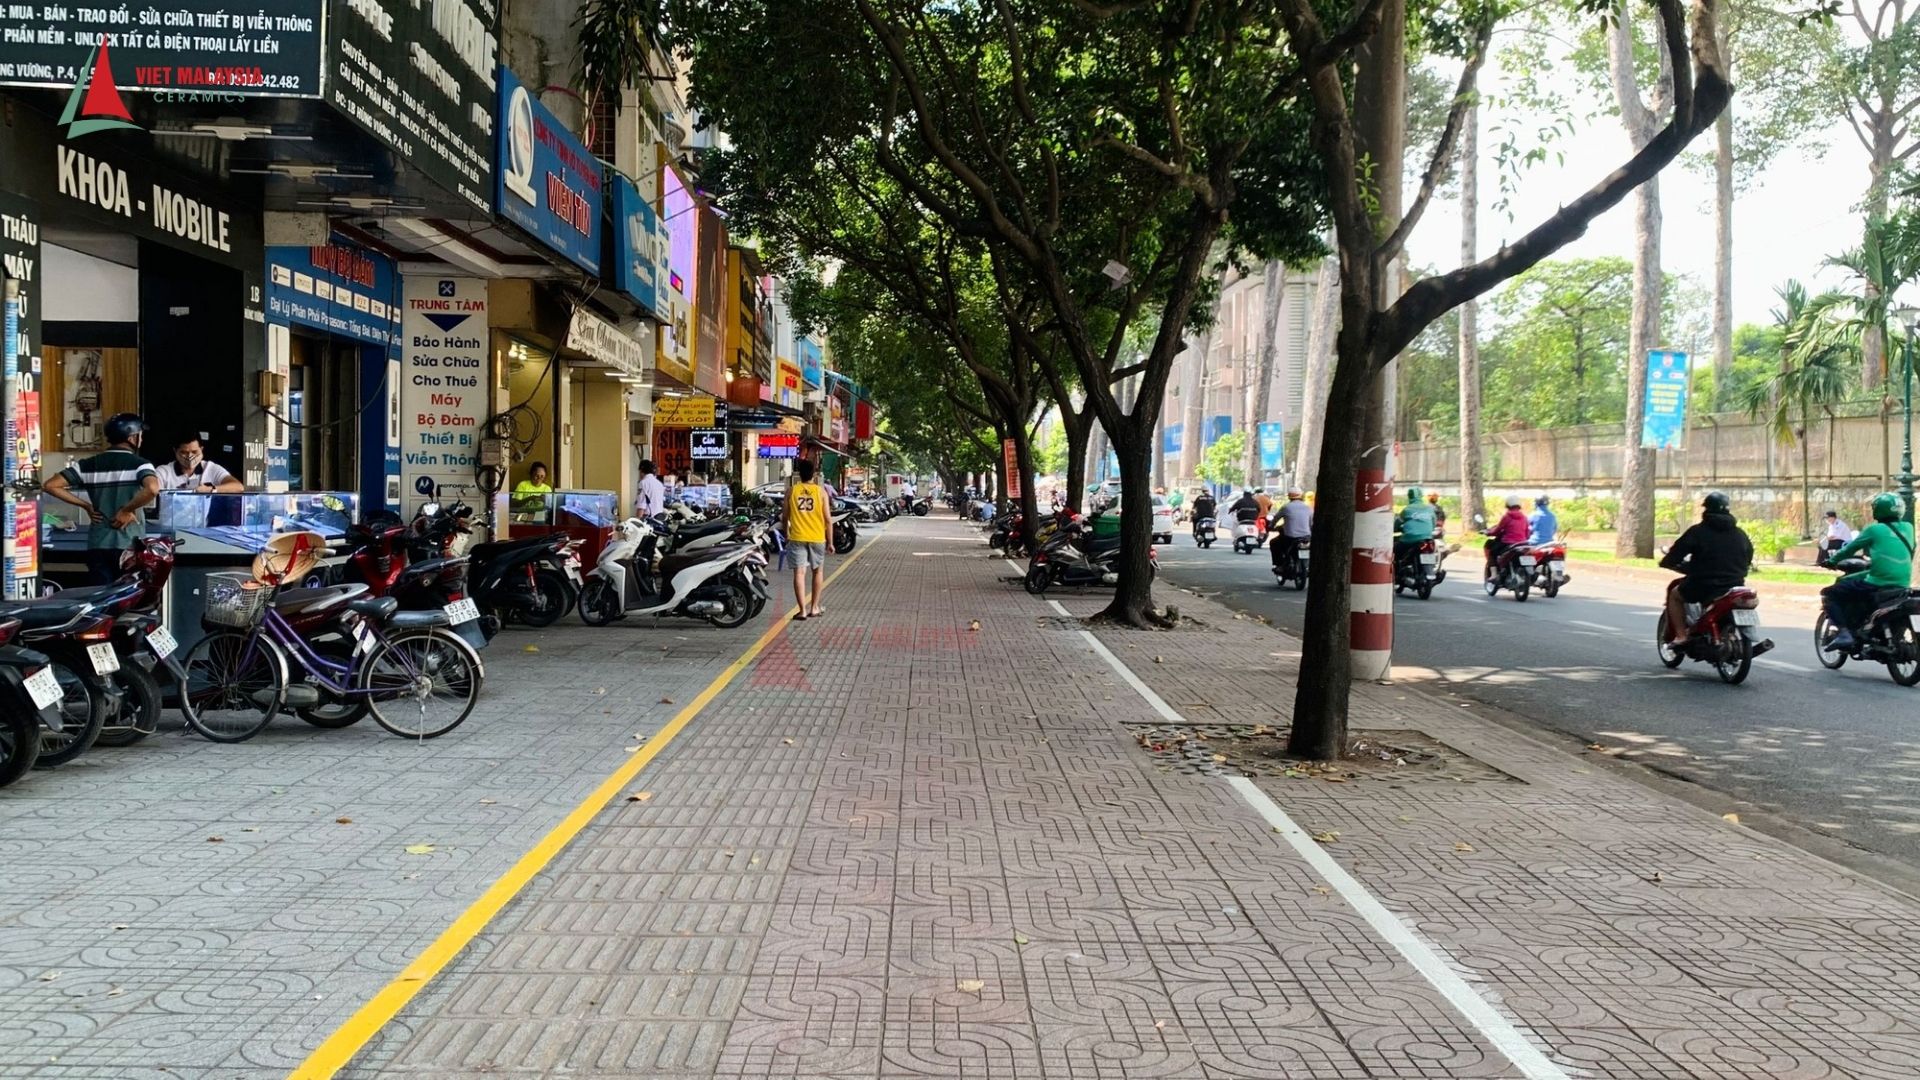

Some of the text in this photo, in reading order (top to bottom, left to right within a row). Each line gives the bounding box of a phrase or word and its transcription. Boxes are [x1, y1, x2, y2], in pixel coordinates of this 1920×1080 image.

[9, 5, 34, 19] MUA
[44, 4, 67, 21] BÁN
[77, 8, 107, 23] TRAO
[110, 3, 129, 24] ĐỔI
[139, 6, 161, 25] SỬA
[164, 9, 194, 27] CHỮA
[197, 9, 229, 28] THIẾT
[232, 14, 244, 32] BỊ
[247, 10, 273, 30] VIỄN
[275, 14, 313, 32] THÔNG
[4, 23, 34, 43] PHẦN
[37, 24, 65, 45] MỀM
[122, 29, 143, 48] TẤT
[146, 30, 161, 49] CẢ
[164, 32, 191, 52] ĐIỆN
[194, 36, 226, 54] THOẠI
[229, 33, 250, 53] LẤY
[253, 34, 279, 54] LIỀN
[409, 41, 461, 106] SAMSUNG
[57, 144, 132, 218] KHOA
[153, 184, 231, 253] MOBILE
[1, 213, 38, 247] THÂU
[4, 250, 33, 282] MÁY
[250, 285, 260, 303] 1B
[409, 298, 484, 311] TRUNG TÂM
[413, 334, 440, 348] Bảo
[444, 336, 480, 349] Hành
[412, 354, 480, 368] Sửa Chữa
[412, 374, 478, 387] Cho Thuê
[431, 393, 462, 407] Máy
[417, 413, 475, 428] Bộ Đàm
[245, 438, 263, 459] THÂU
[419, 431, 472, 448] Thiết Bị
[660, 430, 687, 449] SIM
[405, 450, 437, 465] Viễn
[246, 466, 262, 487] MÁY
[797, 496, 814, 511] 23
